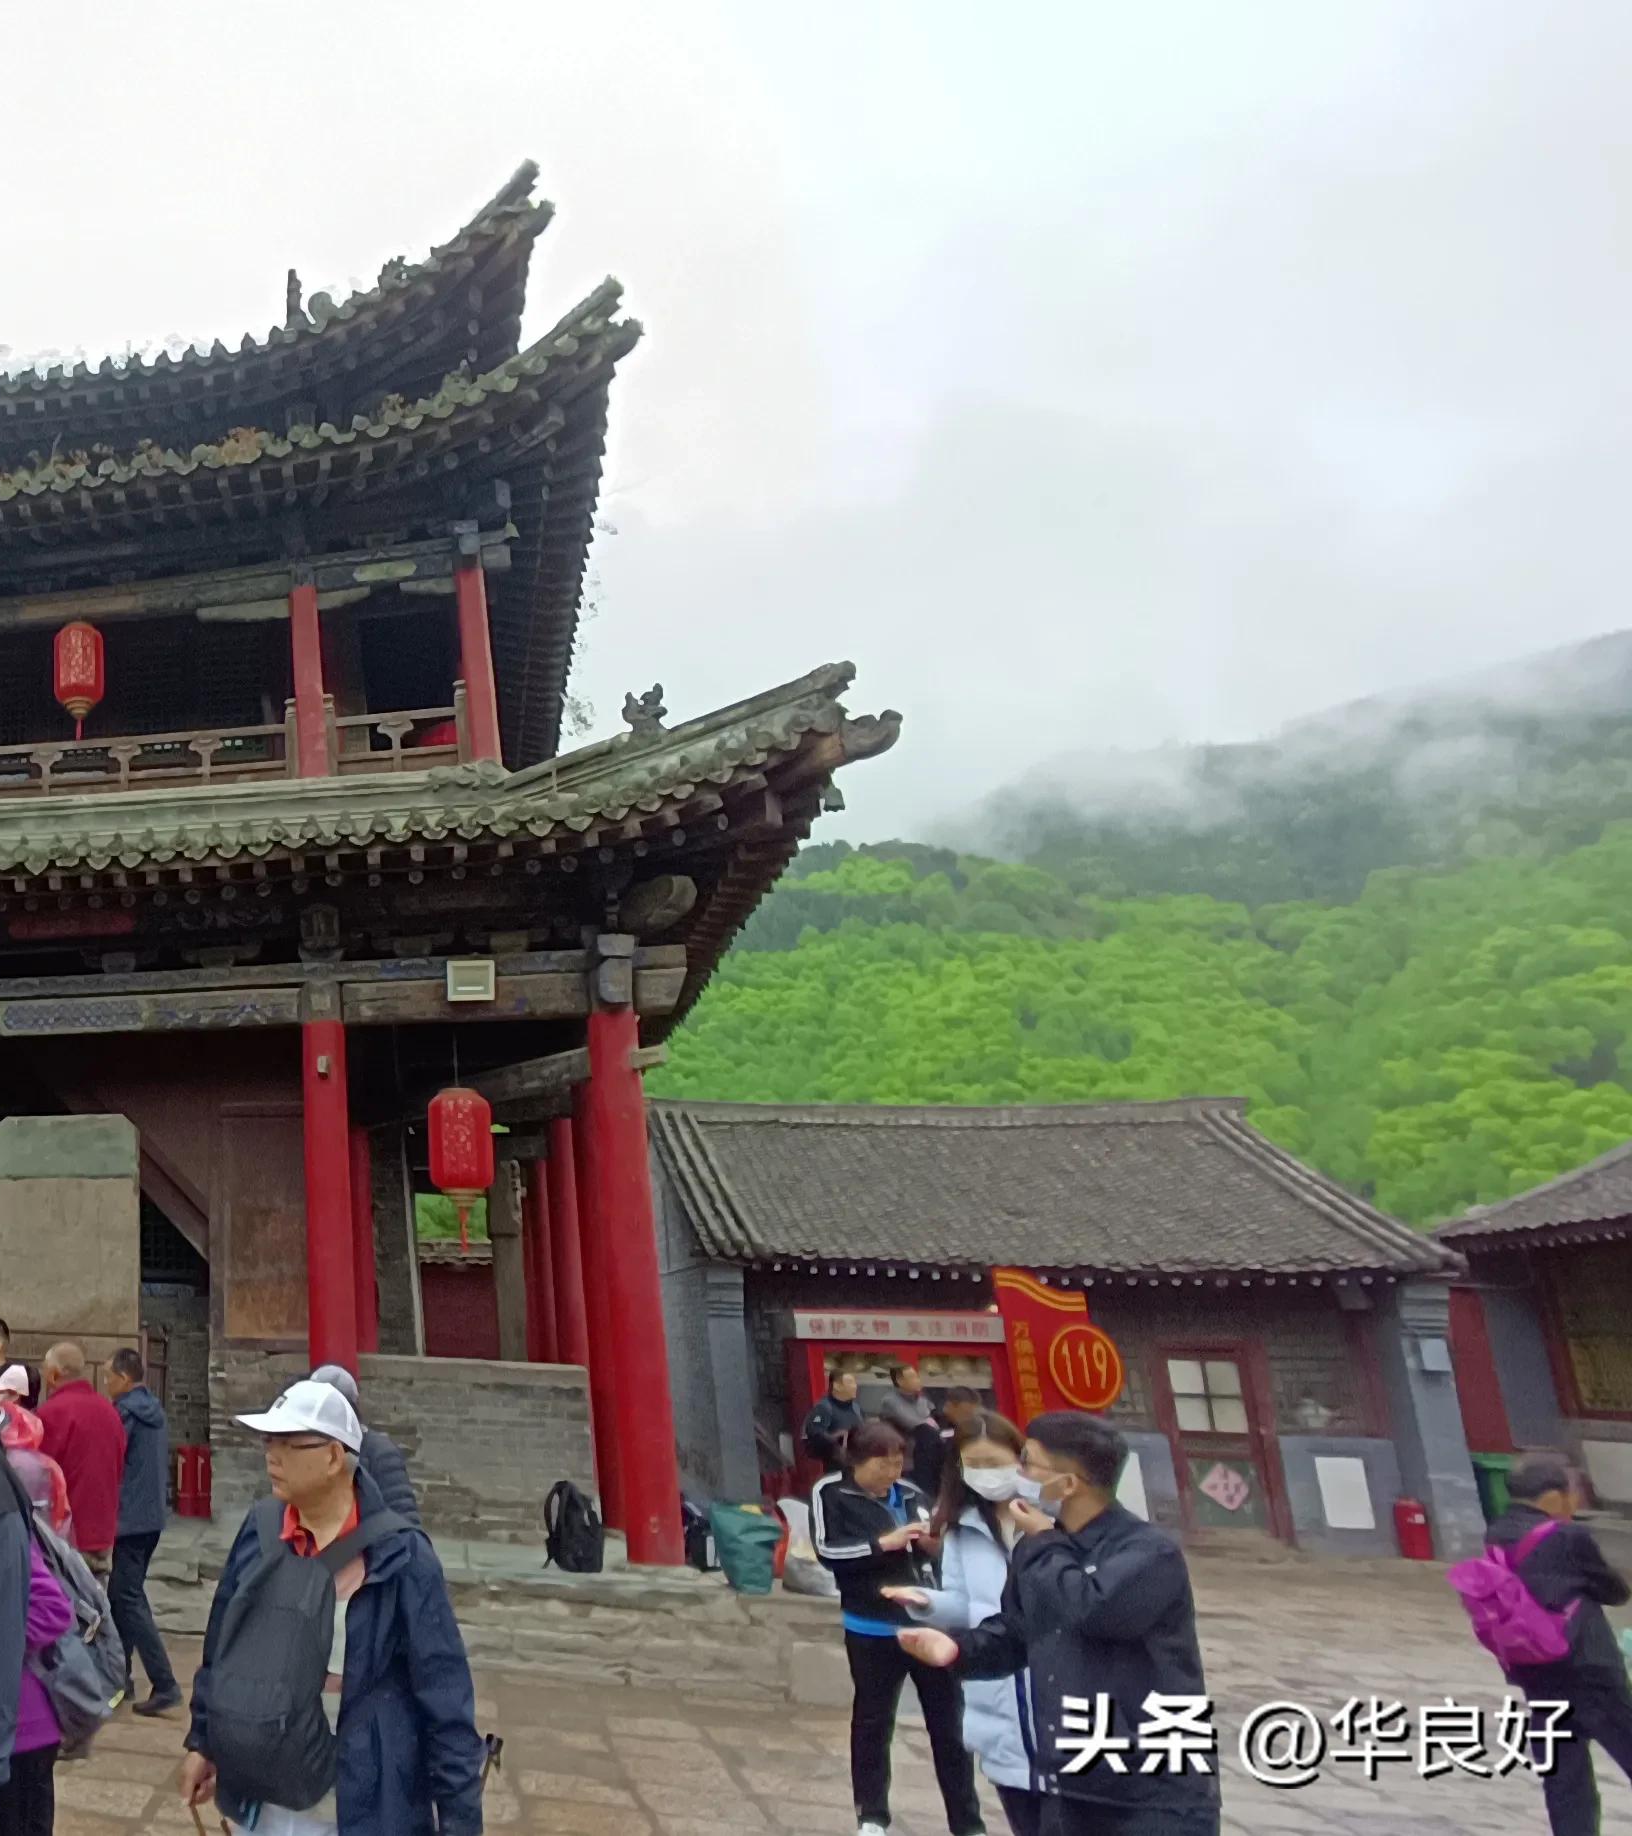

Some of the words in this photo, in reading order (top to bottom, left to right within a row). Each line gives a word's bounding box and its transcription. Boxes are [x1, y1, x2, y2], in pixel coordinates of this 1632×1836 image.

[808, 1318, 891, 1336] 保护文物
[906, 1320, 990, 1338] 关注消防
[1060, 1339, 1108, 1390] 119
